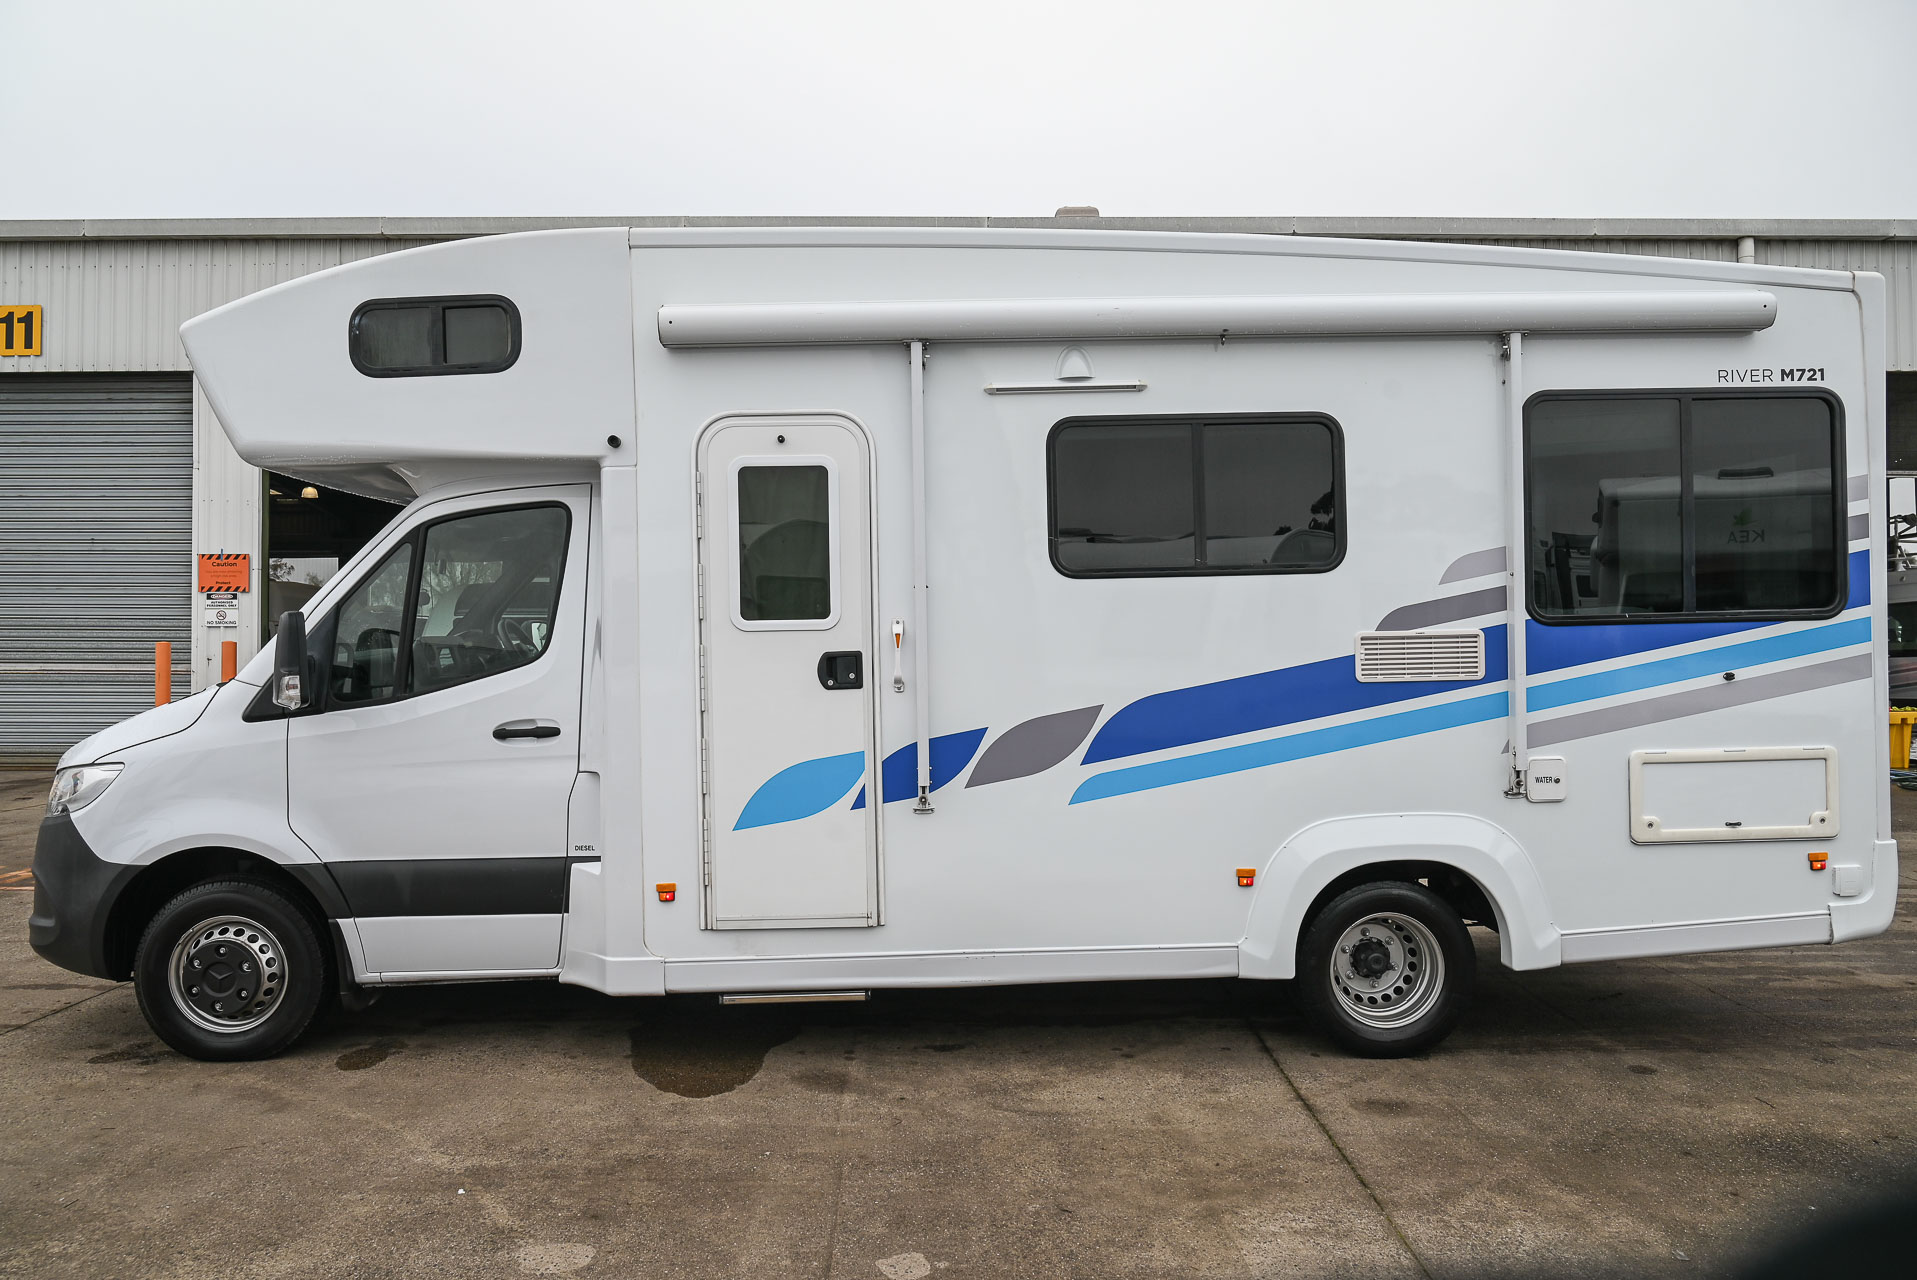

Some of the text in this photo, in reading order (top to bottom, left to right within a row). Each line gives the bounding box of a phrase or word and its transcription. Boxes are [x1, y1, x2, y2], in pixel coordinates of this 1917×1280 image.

[0, 311, 33, 349] 11
[1718, 368, 1825, 382] RIVER M721
[1534, 776, 1553, 784] WATER
